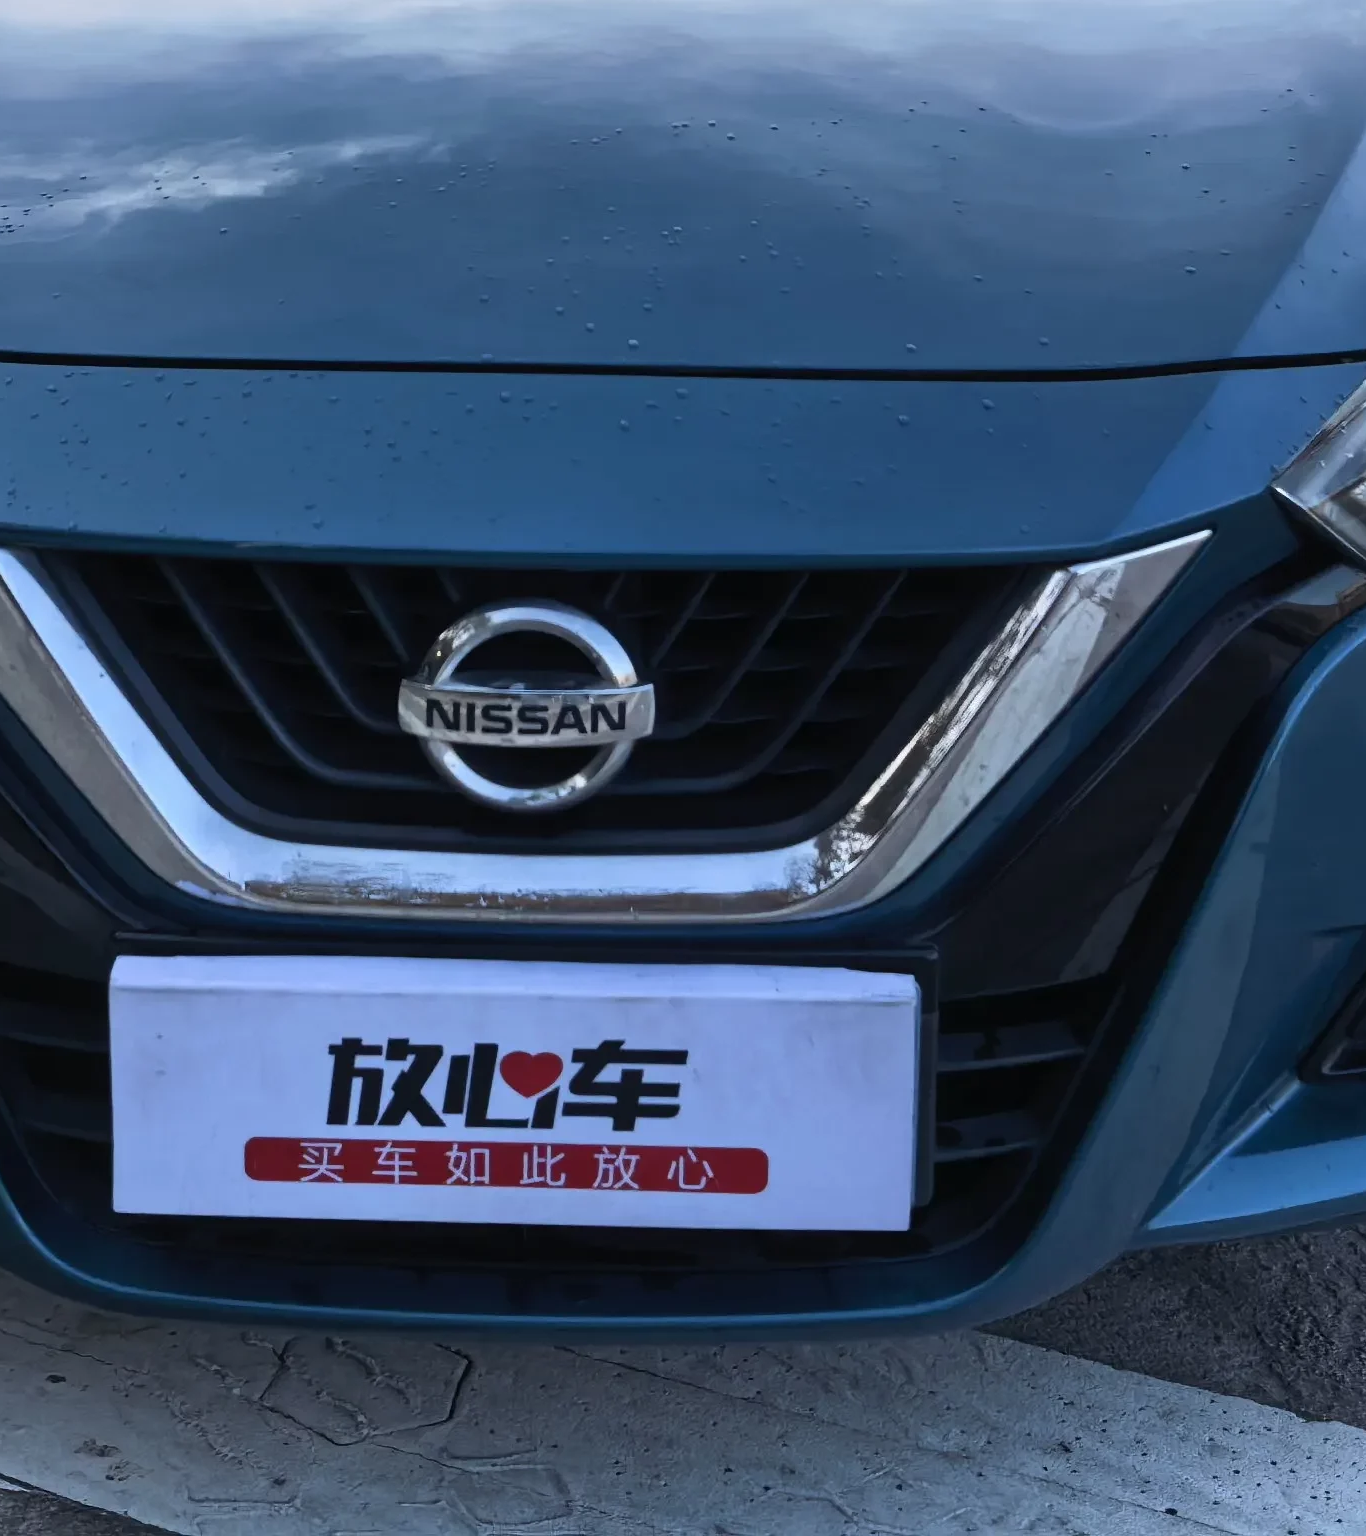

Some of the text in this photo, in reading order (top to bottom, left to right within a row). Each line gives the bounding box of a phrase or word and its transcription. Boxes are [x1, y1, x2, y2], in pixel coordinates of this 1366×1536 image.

[426, 698, 627, 735] NISSAN
[326, 1037, 688, 1132] 放心车
[298, 1141, 715, 1193] 买车如此放心
